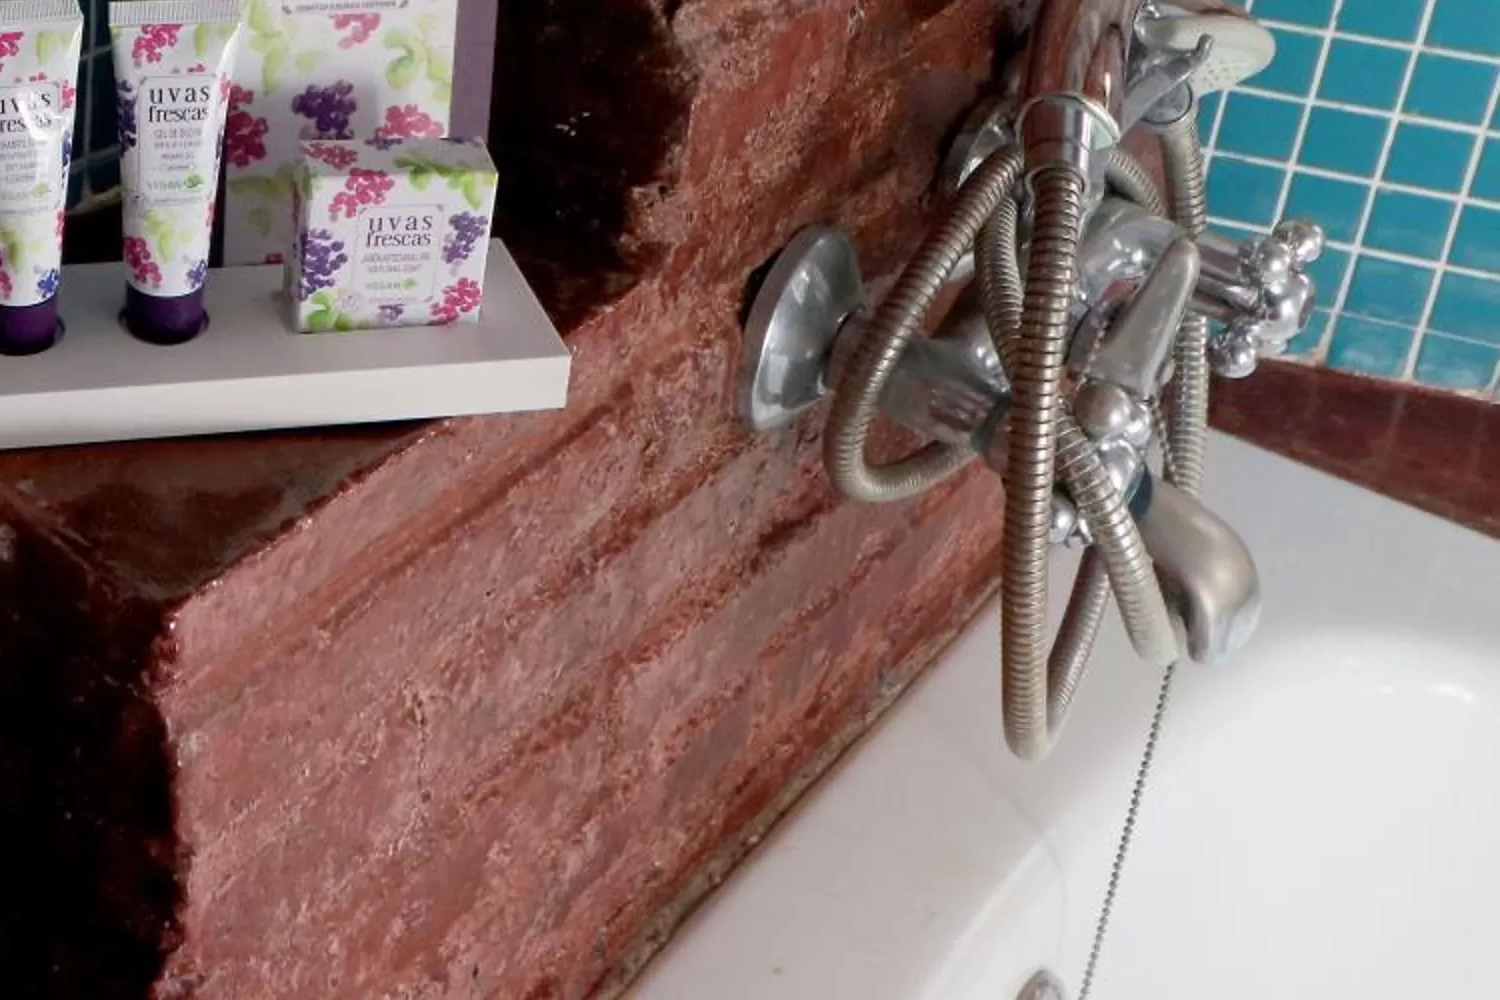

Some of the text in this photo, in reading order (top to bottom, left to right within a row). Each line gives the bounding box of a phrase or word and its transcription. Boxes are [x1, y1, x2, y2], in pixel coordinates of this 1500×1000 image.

[148, 85, 211, 104] uvas
[148, 105, 208, 122] frescas
[369, 215, 434, 232] uvas
[366, 231, 432, 248] frescas
